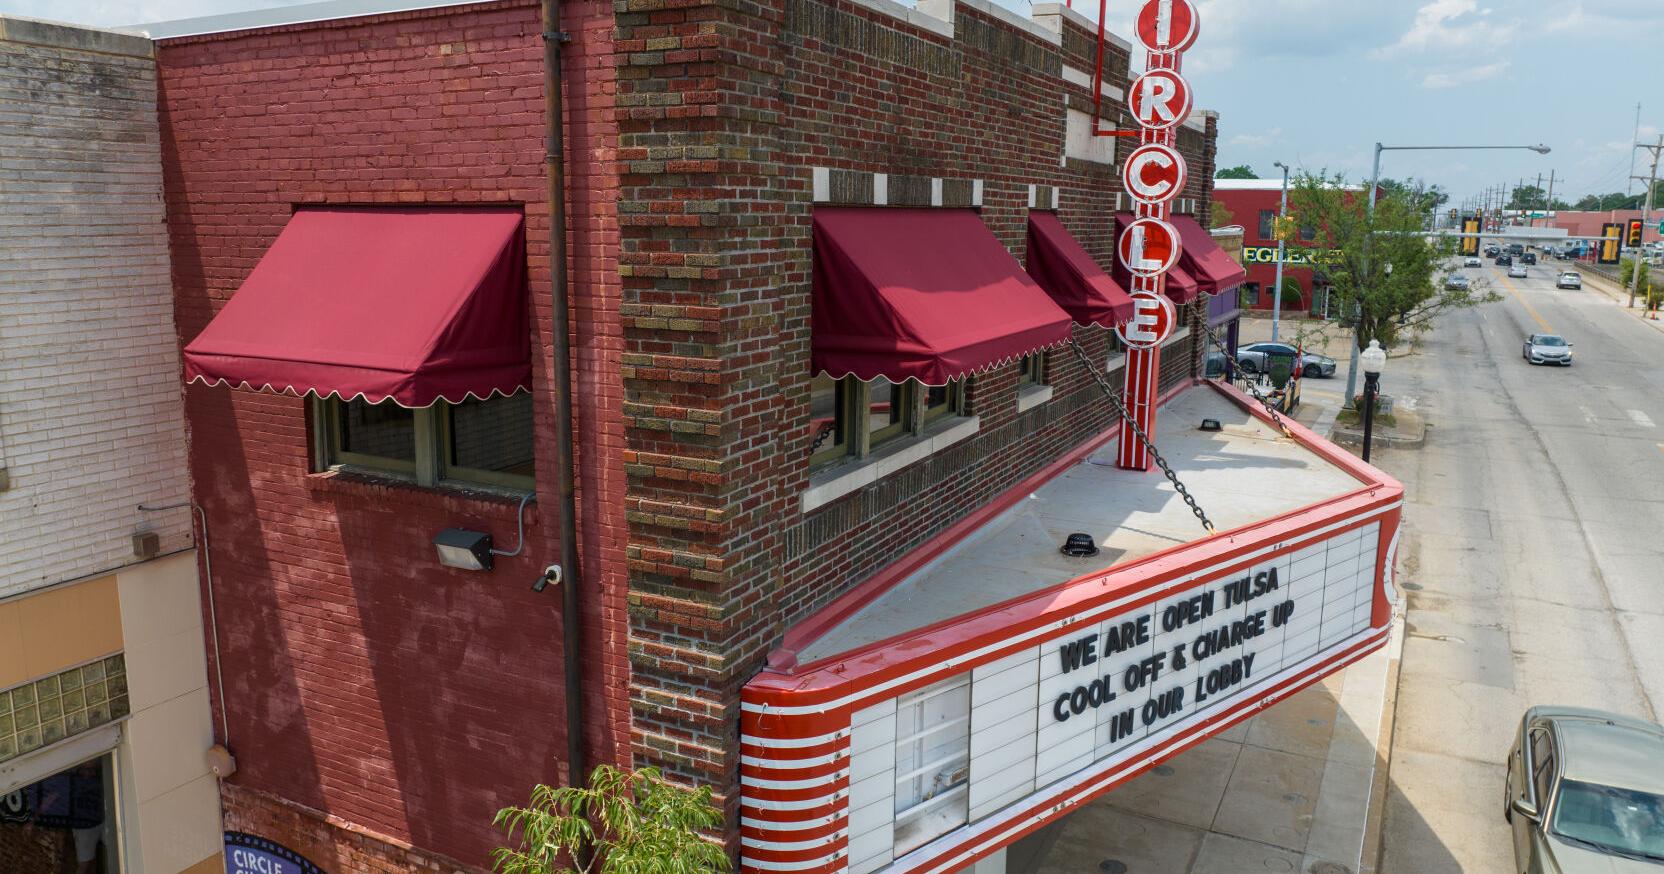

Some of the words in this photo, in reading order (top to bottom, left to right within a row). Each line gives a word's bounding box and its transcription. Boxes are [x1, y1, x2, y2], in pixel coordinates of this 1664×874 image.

[1053, 674, 1117, 722] COOL
[1124, 651, 1166, 693] OFF
[1172, 643, 1187, 671] &
[1192, 610, 1266, 661] CHARGE
[1272, 600, 1295, 628] UP
[1060, 633, 1098, 674] WE
[1104, 614, 1150, 657] ARE
[1162, 590, 1215, 632] OPEN
[1224, 567, 1279, 609] TULSA
[1110, 708, 1135, 743] IN
[1142, 686, 1185, 726] OUR
[1195, 652, 1256, 703] LOBBY
[233, 850, 282, 874] CIRCLE
